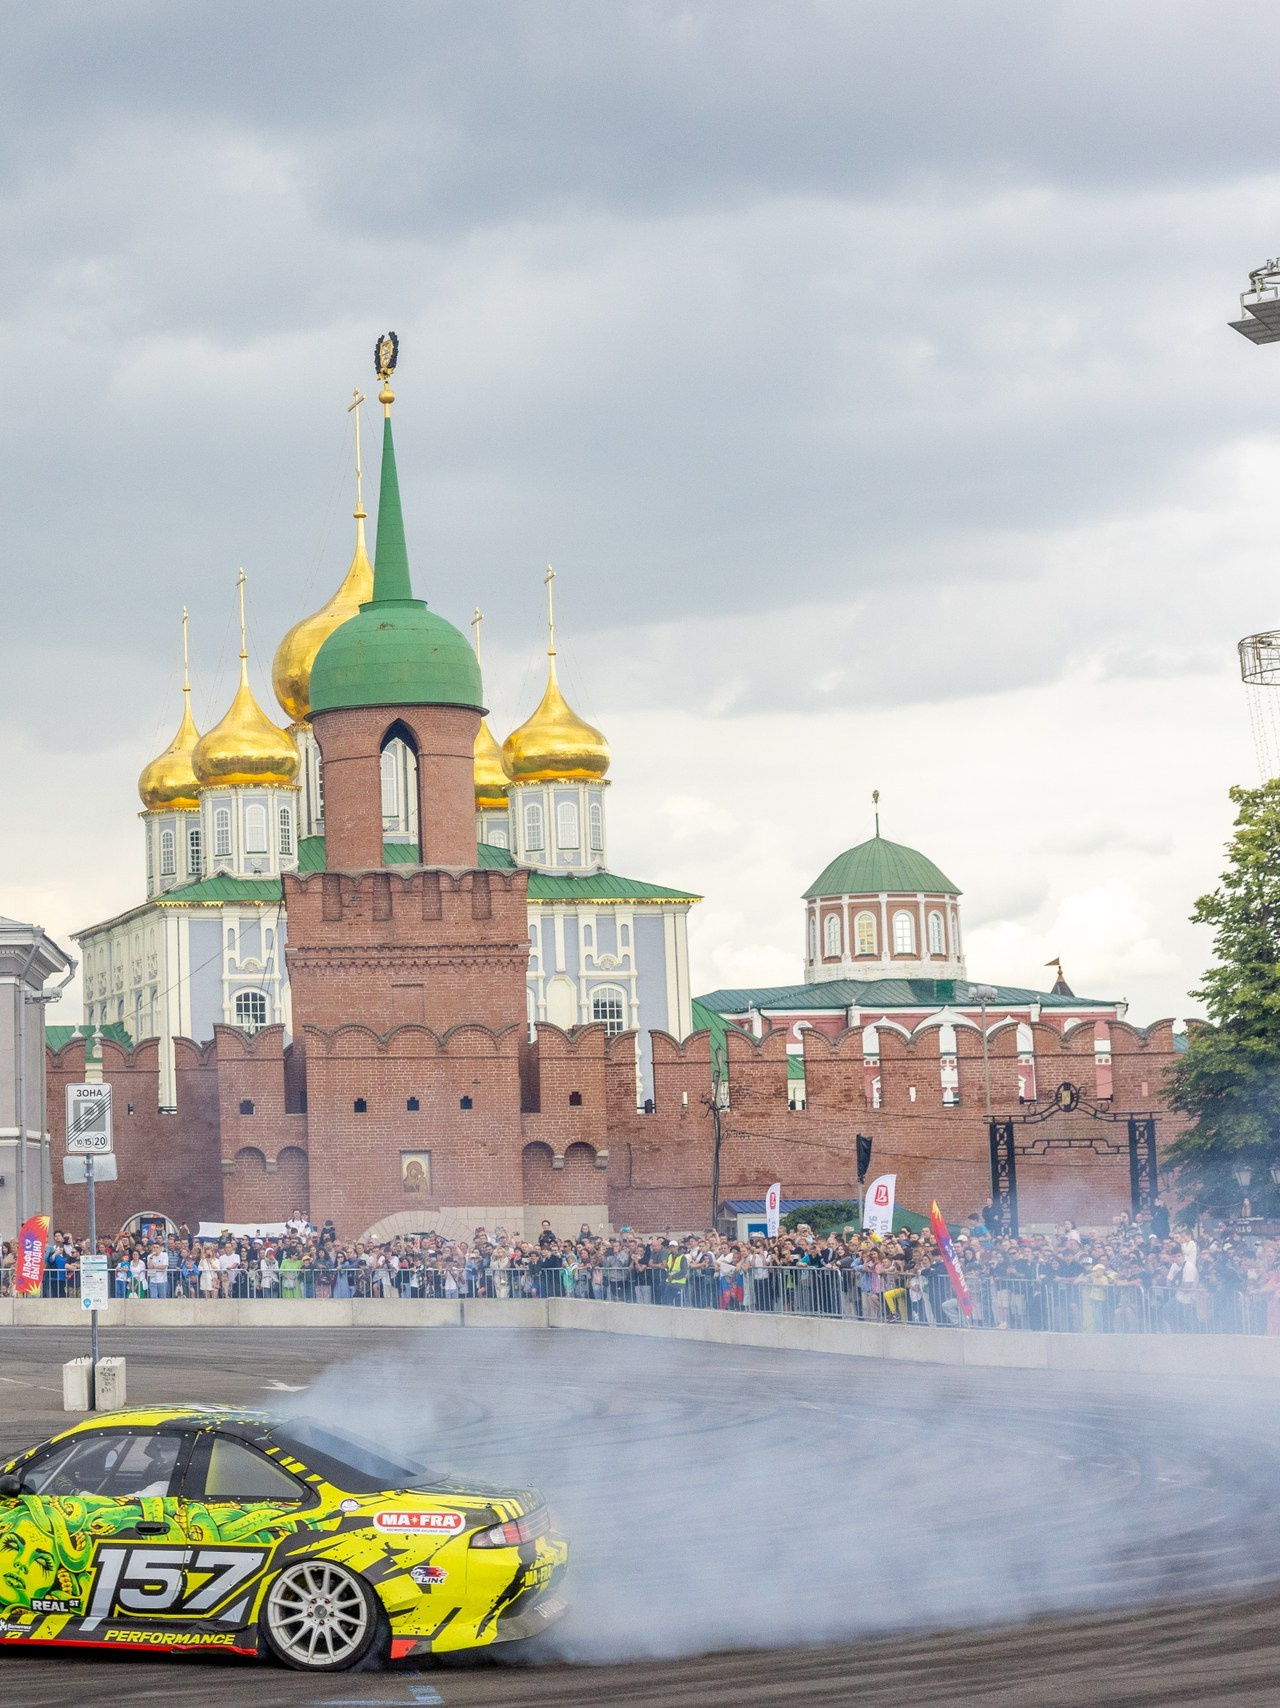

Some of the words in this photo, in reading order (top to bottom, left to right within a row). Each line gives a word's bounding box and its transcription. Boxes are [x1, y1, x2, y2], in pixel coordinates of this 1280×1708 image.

[76, 1089, 103, 1097] ЗОНА
[94, 1137, 106, 1146] 20
[22, 1250, 32, 1278] АЛЬФА
[30, 1240, 42, 1280] ВЫГОДНО
[79, 1549, 265, 1631] 157
[32, 1599, 69, 1612] REAL
[104, 1629, 236, 1645] PERFORMANCE
